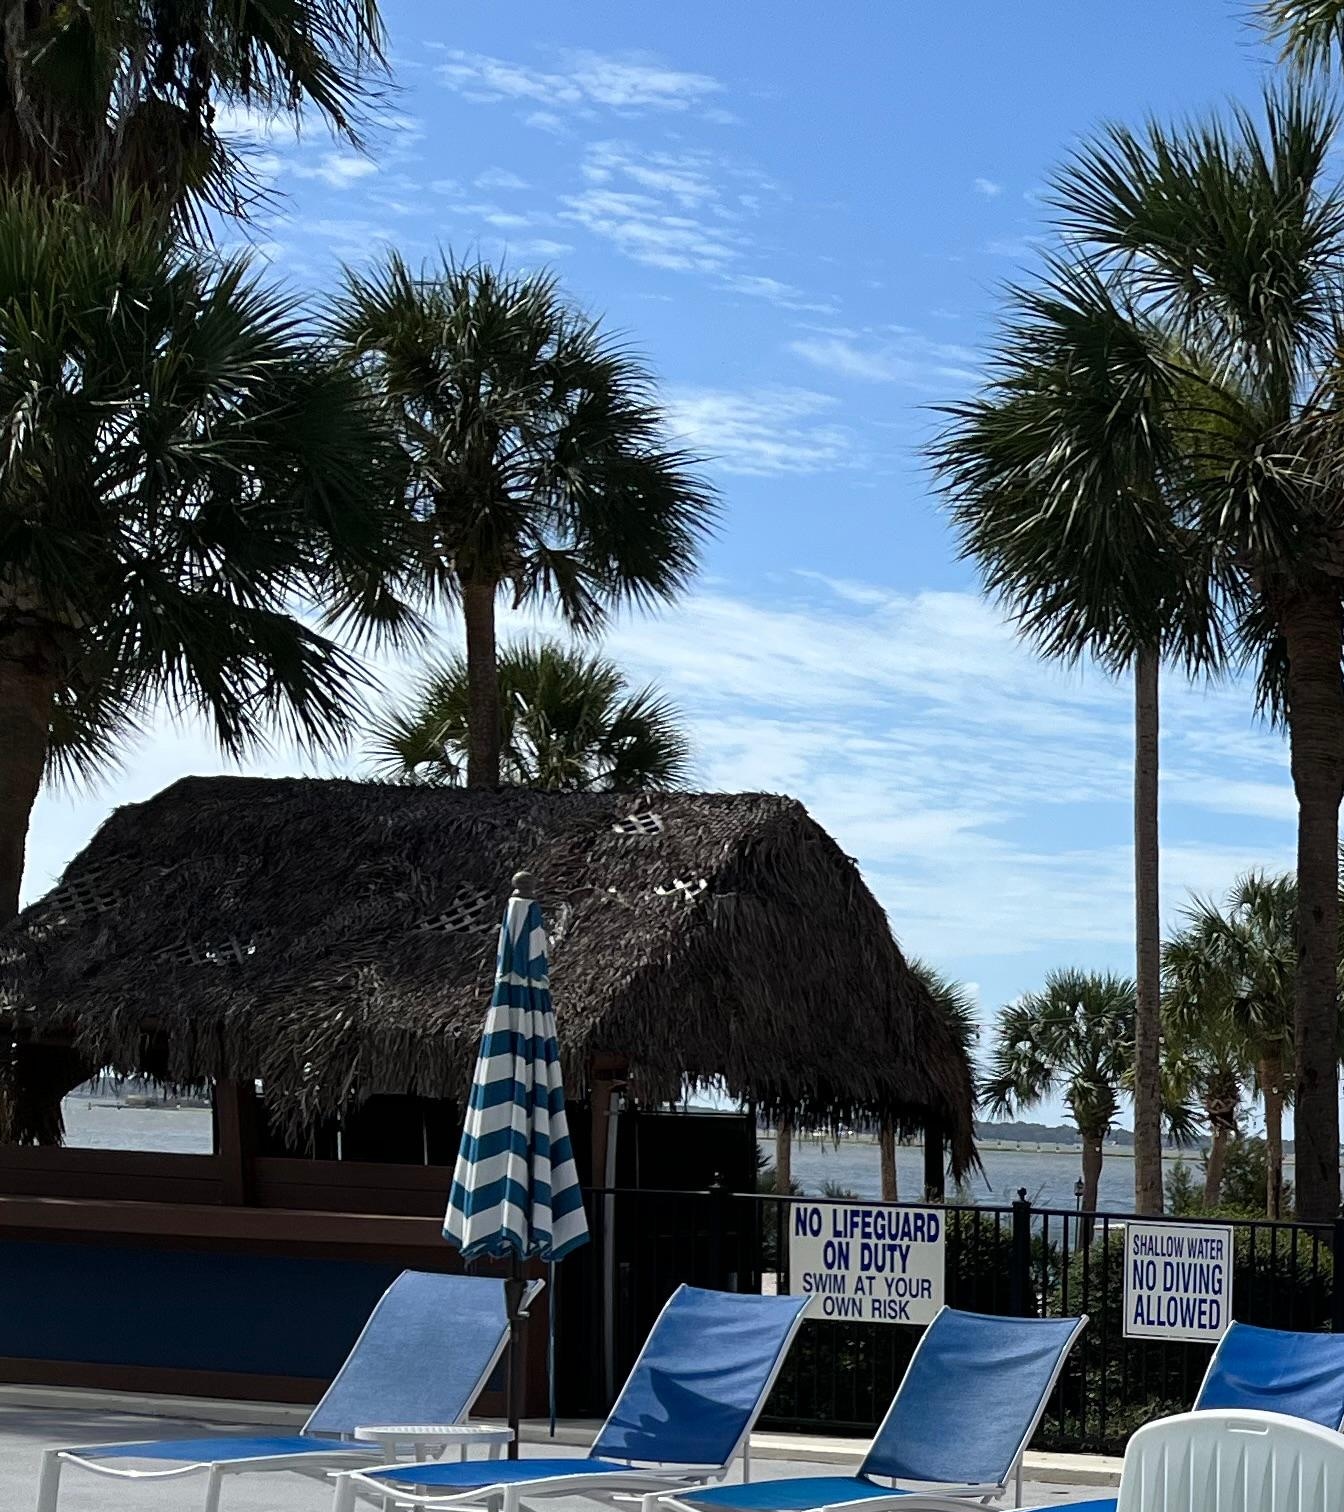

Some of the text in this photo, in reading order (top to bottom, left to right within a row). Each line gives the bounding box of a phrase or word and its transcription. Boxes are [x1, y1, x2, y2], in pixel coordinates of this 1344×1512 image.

[795, 1207, 940, 1243] NO LIFEGUARD
[823, 1240, 911, 1274] ON DUTY
[1133, 1234, 1223, 1260] SHALLOW WATER
[802, 1272, 932, 1299] SWIM AT YOUR
[1132, 1259, 1223, 1295] NO DIVING
[823, 1296, 910, 1320] OWN RISK
[1133, 1294, 1220, 1330] ALLOWED
